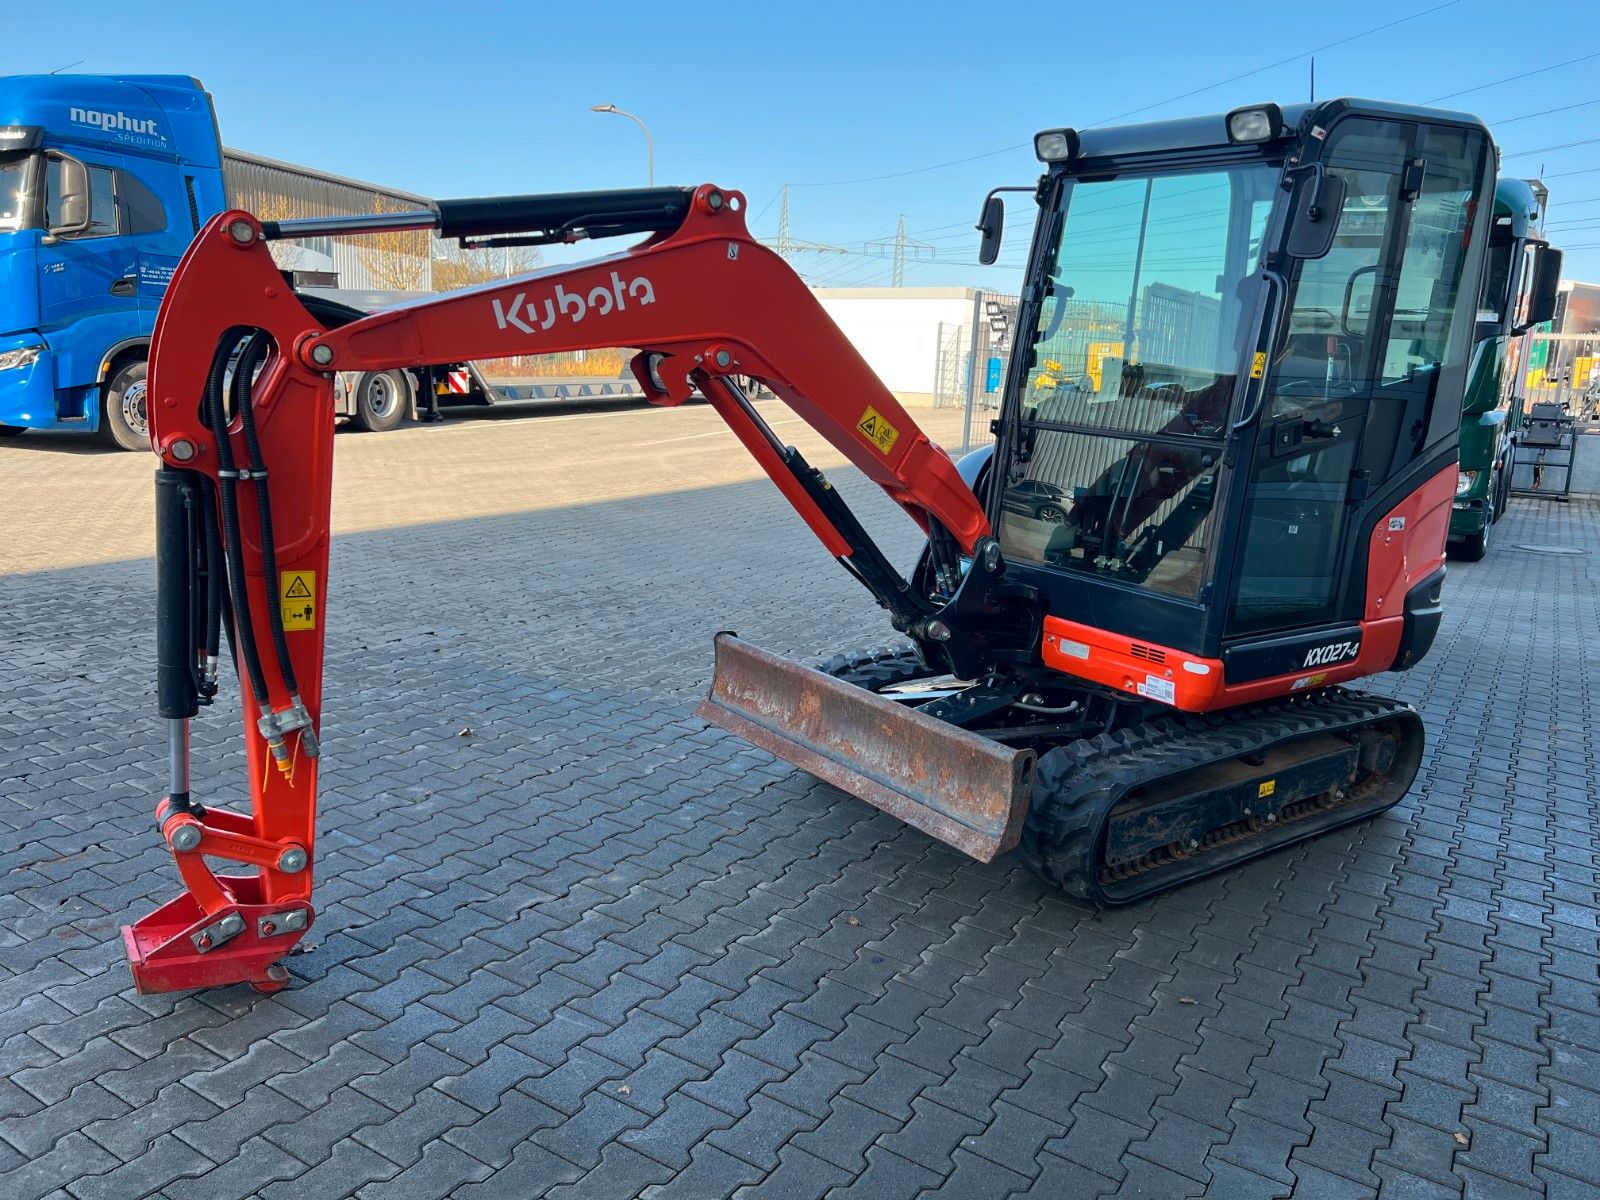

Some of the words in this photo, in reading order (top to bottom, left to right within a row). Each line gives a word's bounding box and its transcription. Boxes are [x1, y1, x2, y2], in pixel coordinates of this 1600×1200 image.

[70, 107, 158, 136] nophut
[117, 133, 167, 148] SPEDITION
[491, 271, 656, 334] Kubota
[1302, 641, 1360, 668] KX027-4
